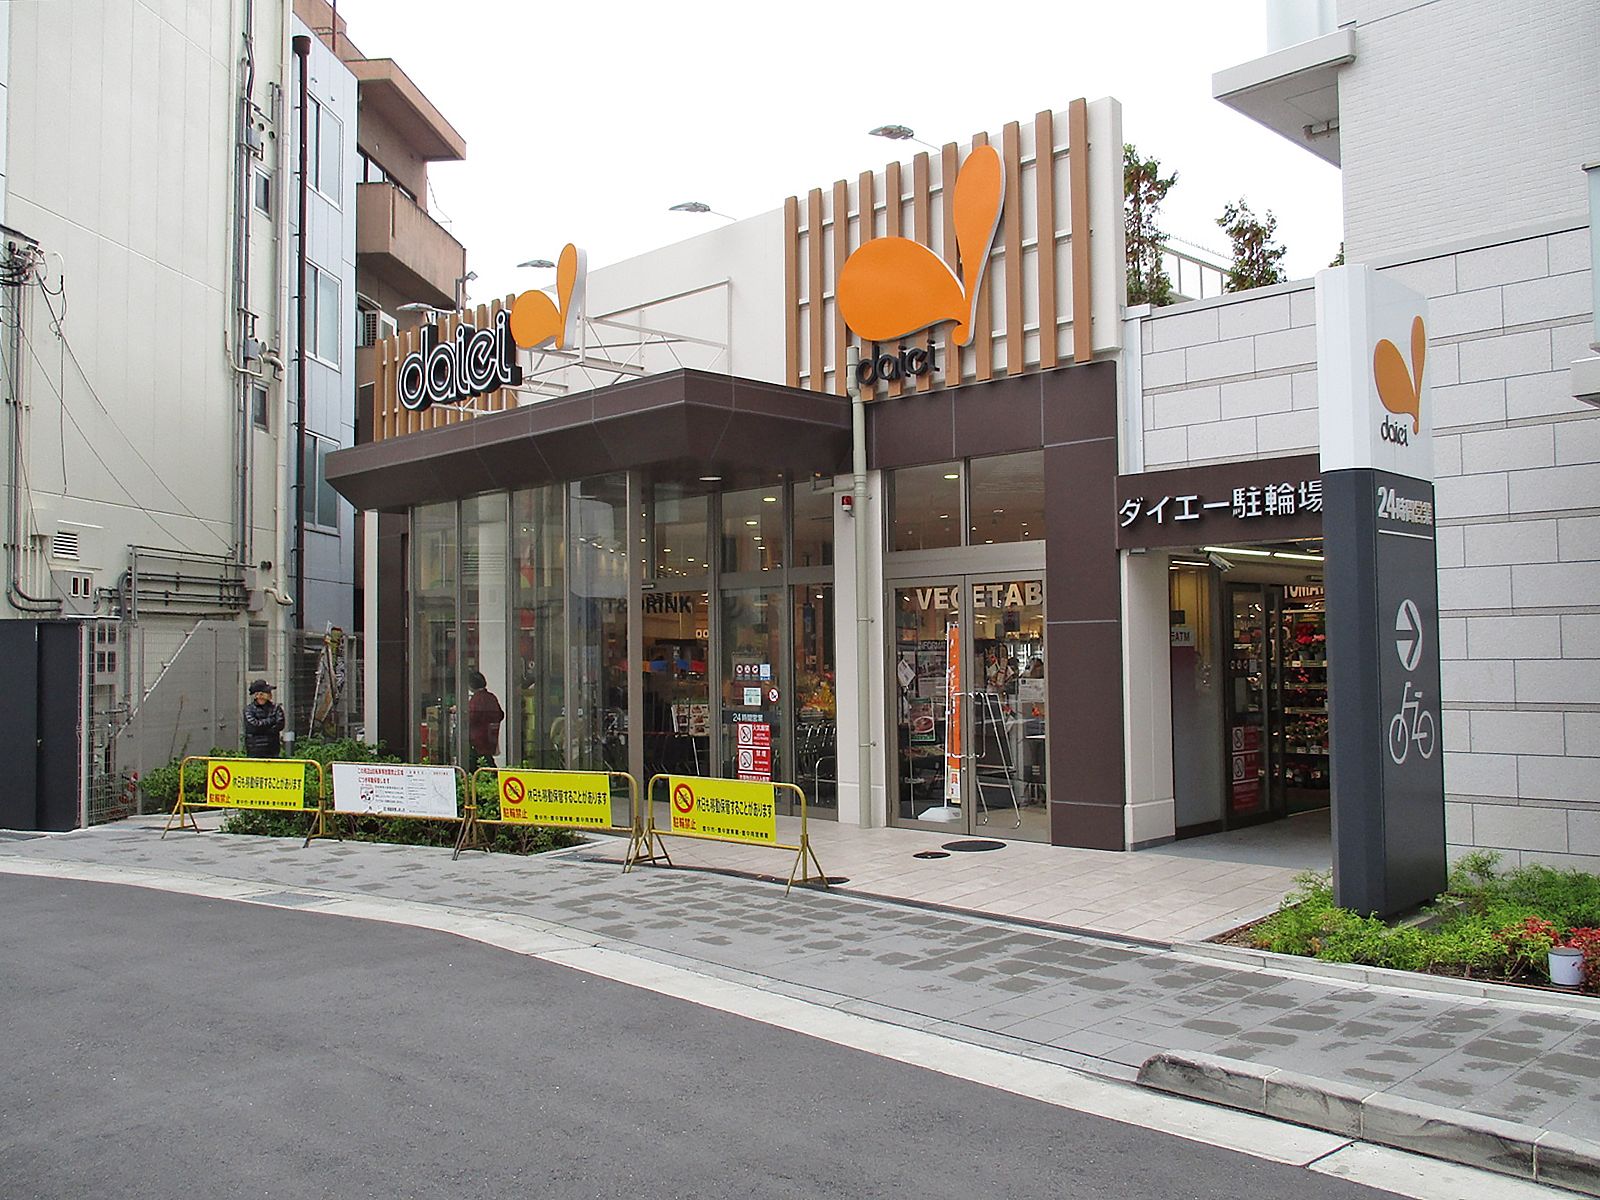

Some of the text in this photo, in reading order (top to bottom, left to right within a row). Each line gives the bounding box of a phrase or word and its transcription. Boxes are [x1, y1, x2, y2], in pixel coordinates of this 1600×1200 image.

[399, 310, 522, 411] daiei
[856, 340, 940, 385] daiei
[1381, 415, 1409, 447] daiei
[1119, 479, 1323, 528] ダイエー駐輪場
[1377, 487, 1433, 525] 24時間営業
[642, 594, 692, 614] RINK
